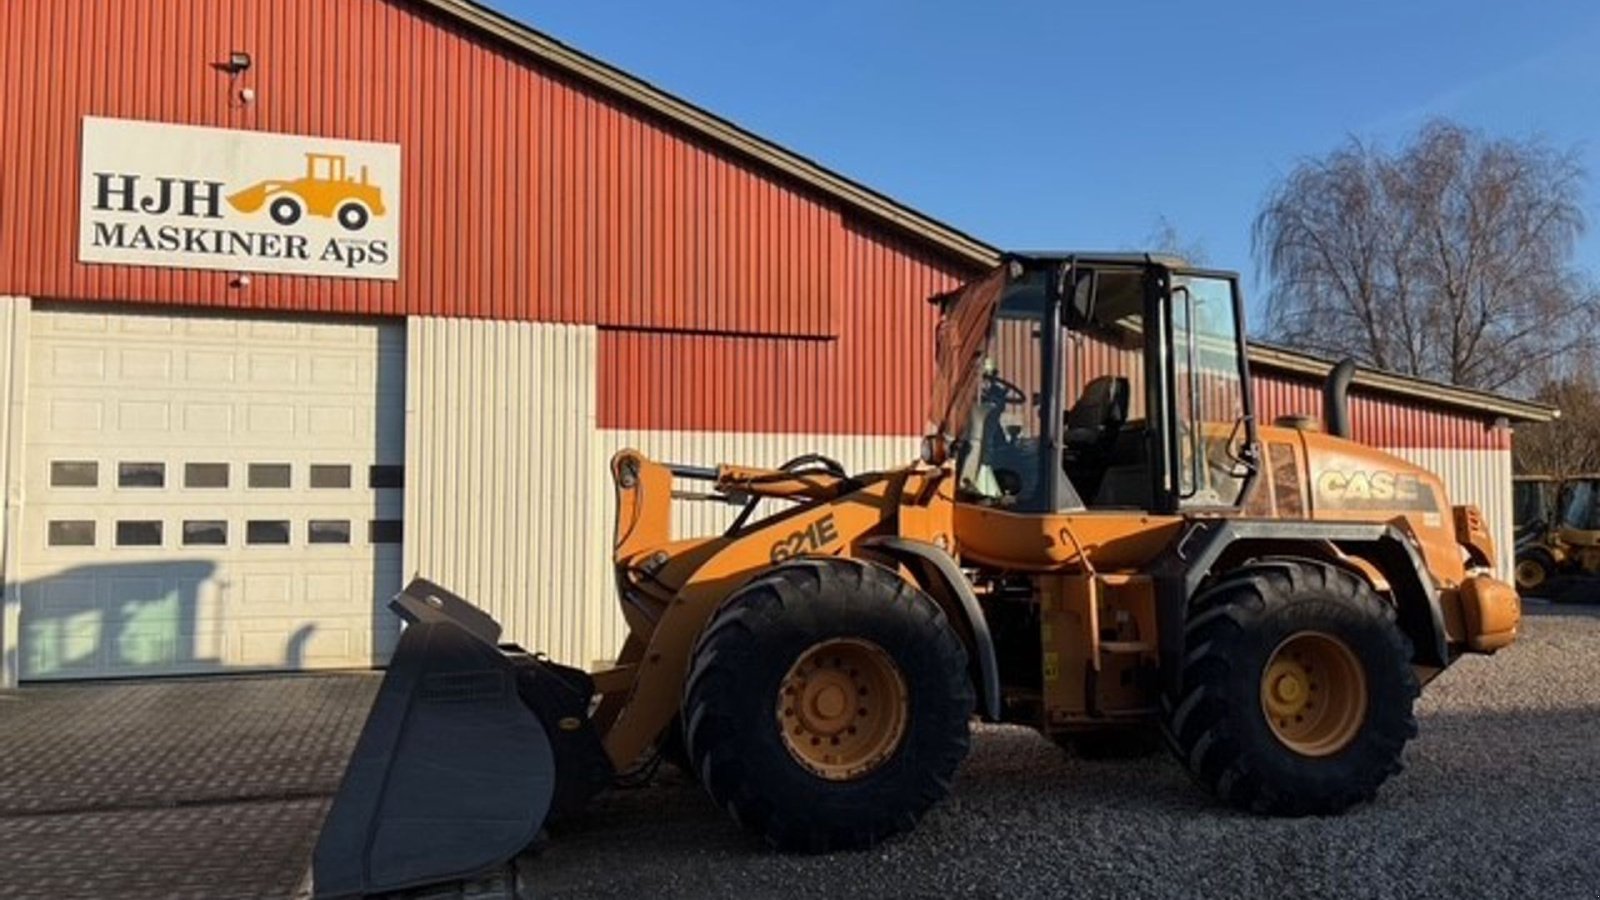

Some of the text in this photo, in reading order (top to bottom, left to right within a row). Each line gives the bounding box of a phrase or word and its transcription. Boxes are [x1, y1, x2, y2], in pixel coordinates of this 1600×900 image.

[92, 172, 224, 218] HJH
[92, 222, 389, 268] MASKINER ApS
[1318, 470, 1419, 500] CASE
[770, 512, 838, 564] 621E
